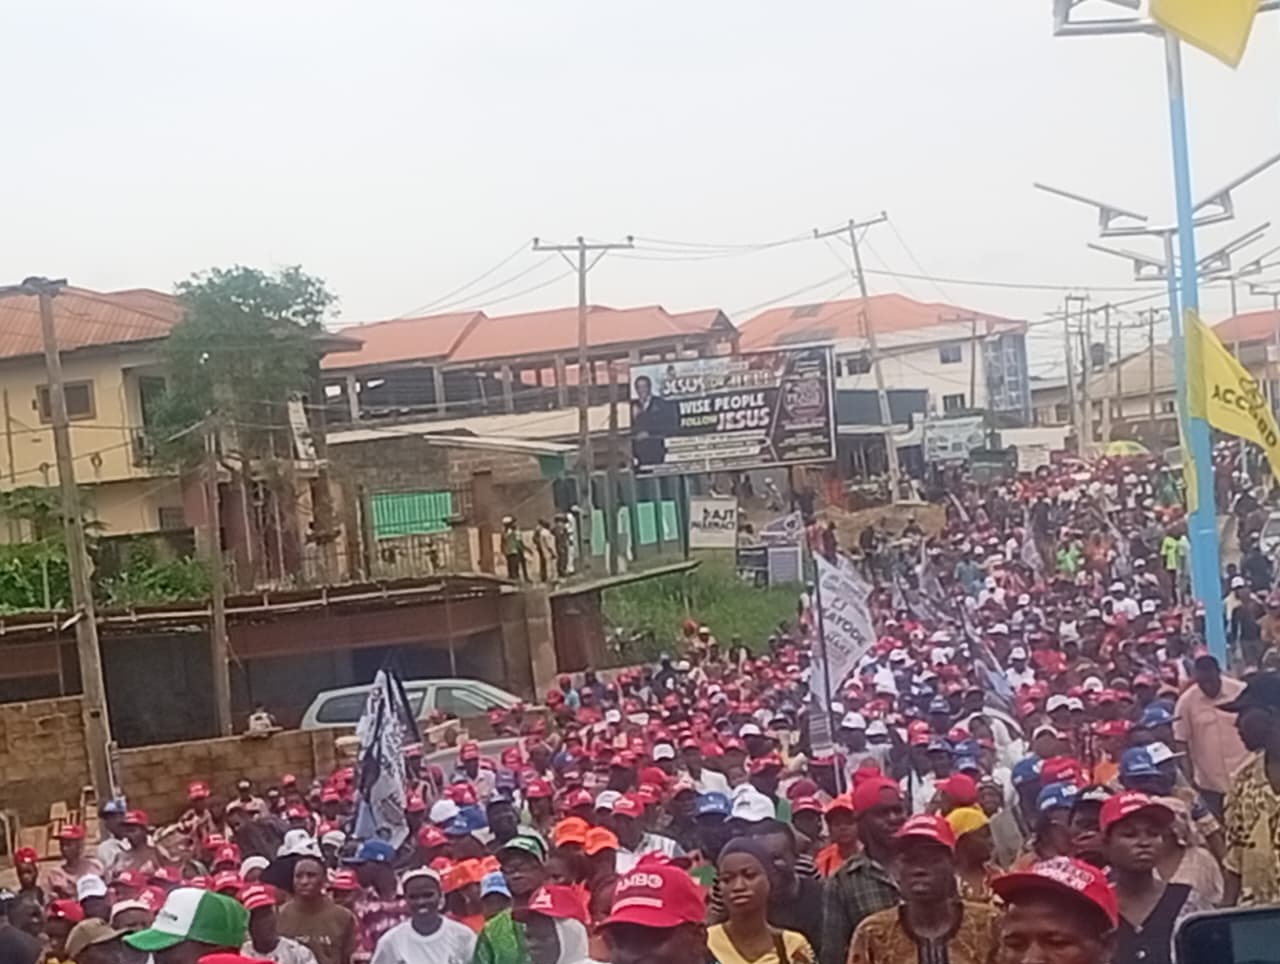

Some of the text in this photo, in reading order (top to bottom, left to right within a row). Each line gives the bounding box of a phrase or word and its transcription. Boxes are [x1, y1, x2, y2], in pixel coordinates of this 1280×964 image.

[680, 399, 711, 415] WISE
[715, 393, 765, 412] PEOPLE
[681, 415, 717, 427] FOLLOW
[717, 407, 770, 431] JESUS
